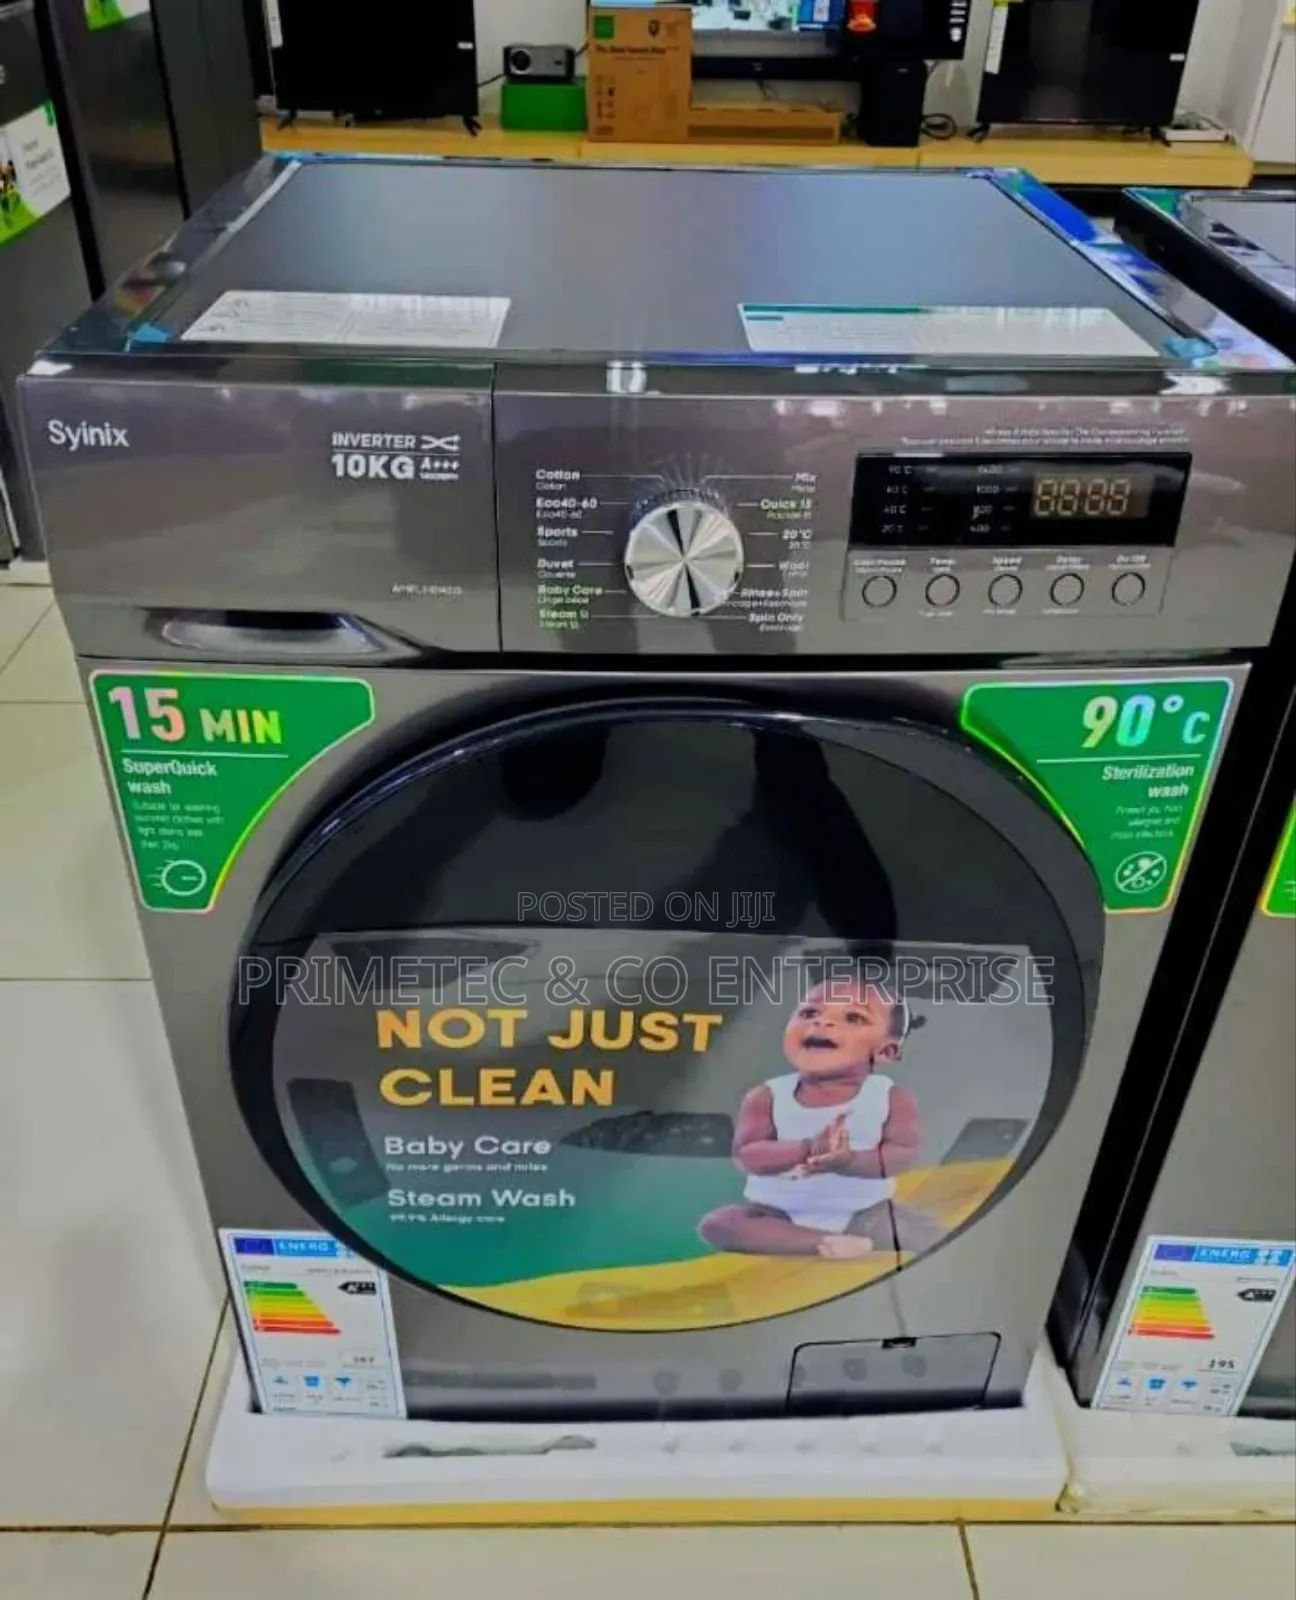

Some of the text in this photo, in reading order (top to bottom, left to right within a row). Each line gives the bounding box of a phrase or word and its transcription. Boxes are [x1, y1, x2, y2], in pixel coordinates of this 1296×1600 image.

[47, 418, 130, 452] Syinix
[332, 431, 417, 449] INVERTER
[331, 453, 415, 480] 10KG
[535, 468, 581, 481] Cotton
[535, 496, 599, 509] Eco40-60
[537, 524, 579, 538] Sports
[537, 557, 575, 569] Duvet
[537, 584, 604, 597] Baby Care
[107, 685, 283, 745] 15 MIN
[122, 757, 218, 778] SuperQuick
[1101, 763, 1194, 781] Sterilization
[127, 779, 172, 795] wash
[1147, 782, 1188, 798] wash
[376, 1008, 724, 1053] NOT JUST
[378, 1067, 615, 1107] CLEAN
[384, 1135, 553, 1160] Baby Care
[387, 1188, 577, 1208] Steam Wash
[1199, 1247, 1252, 1261] ENERG
